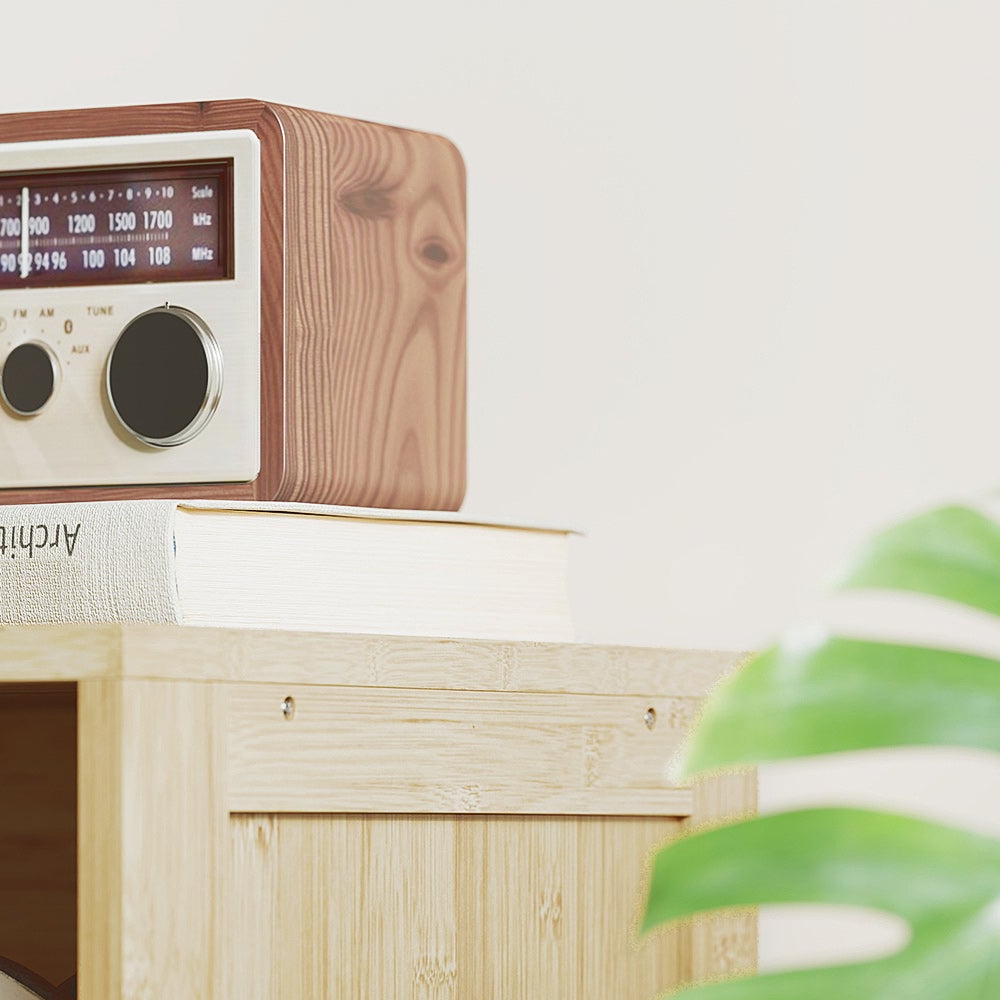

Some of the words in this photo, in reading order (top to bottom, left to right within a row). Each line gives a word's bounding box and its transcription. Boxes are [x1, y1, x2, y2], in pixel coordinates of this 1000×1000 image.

[33, 192, 42, 206] 3
[52, 192, 60, 204] 4
[70, 190, 78, 204] 5
[89, 190, 97, 203] 6
[107, 188, 115, 201] 7
[126, 188, 134, 201] 8
[144, 187, 152, 200] 9
[161, 185, 175, 199] 10
[191, 184, 214, 199] Scale
[0, 217, 21, 237] 700
[28, 215, 50, 235] 900
[67, 213, 96, 234] 1200
[108, 211, 136, 232] 1500
[143, 209, 173, 230] 1700
[192, 212, 213, 227] kHz
[0, 252, 17, 273] 90
[34, 252, 50, 271] 94
[50, 250, 68, 271] 96
[82, 248, 105, 269] 100
[113, 247, 136, 267] 104
[148, 245, 172, 266] 108
[191, 246, 214, 261] MHz
[13, 309, 28, 319] FM
[39, 308, 55, 318] AM
[86, 306, 114, 317] TUNE
[71, 345, 91, 355] AUX
